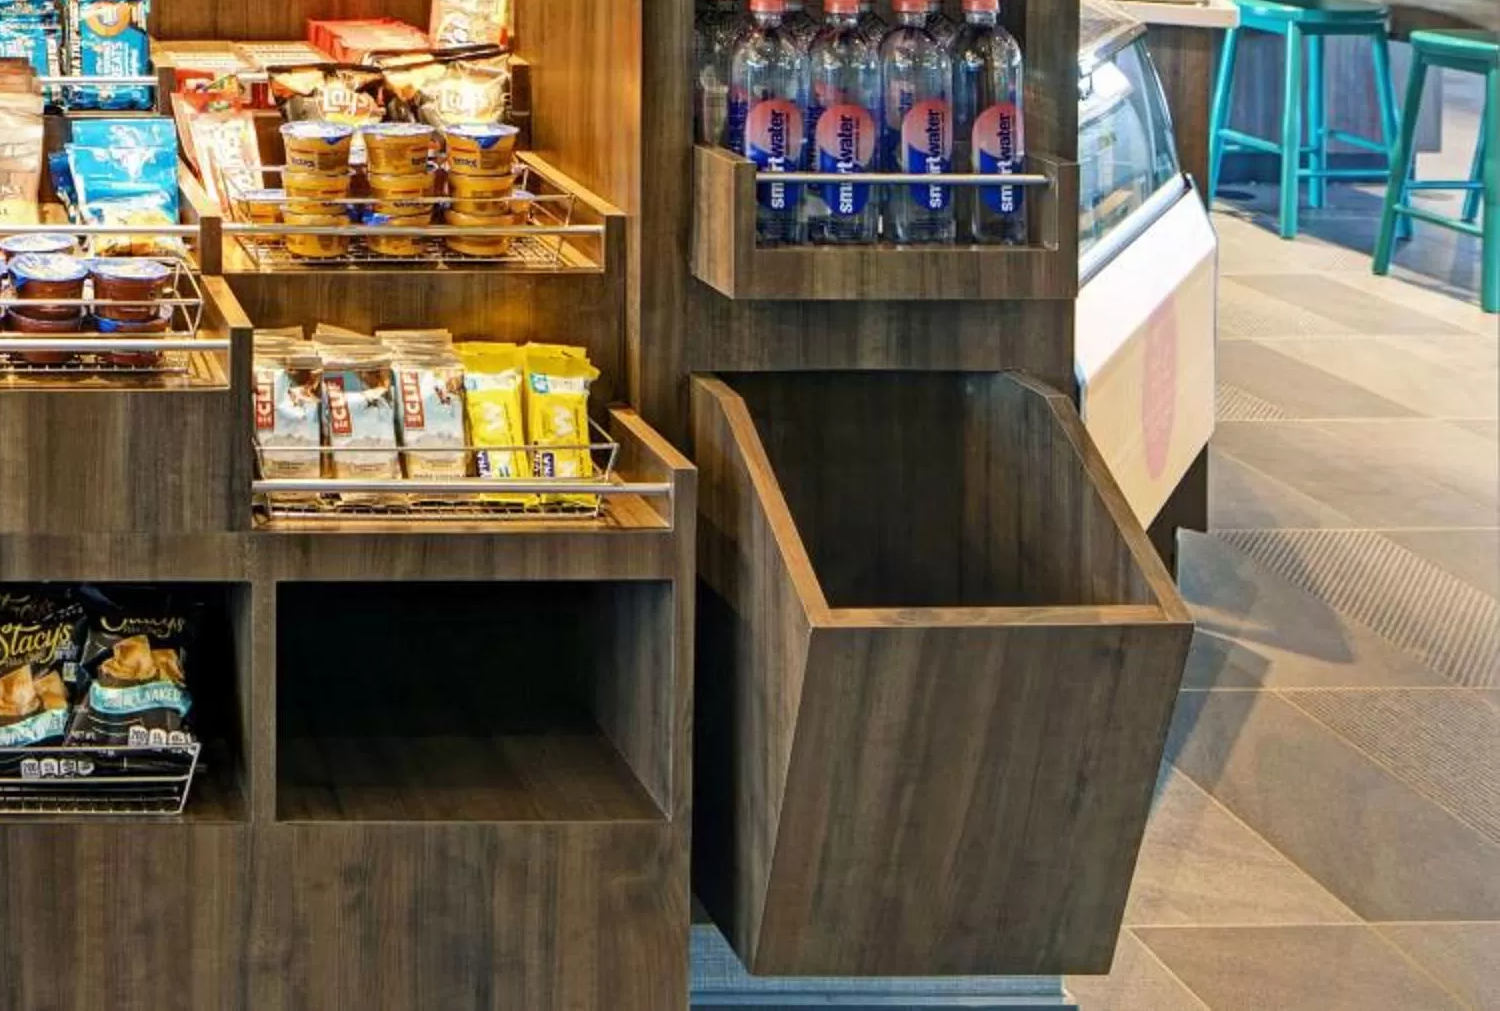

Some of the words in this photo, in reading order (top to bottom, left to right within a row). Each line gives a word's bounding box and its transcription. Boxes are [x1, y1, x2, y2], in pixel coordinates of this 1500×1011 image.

[768, 108, 785, 209] smrtwater
[836, 114, 853, 214] smrtwater
[926, 108, 942, 208] smrtwater
[997, 112, 1013, 212] smrtwater
